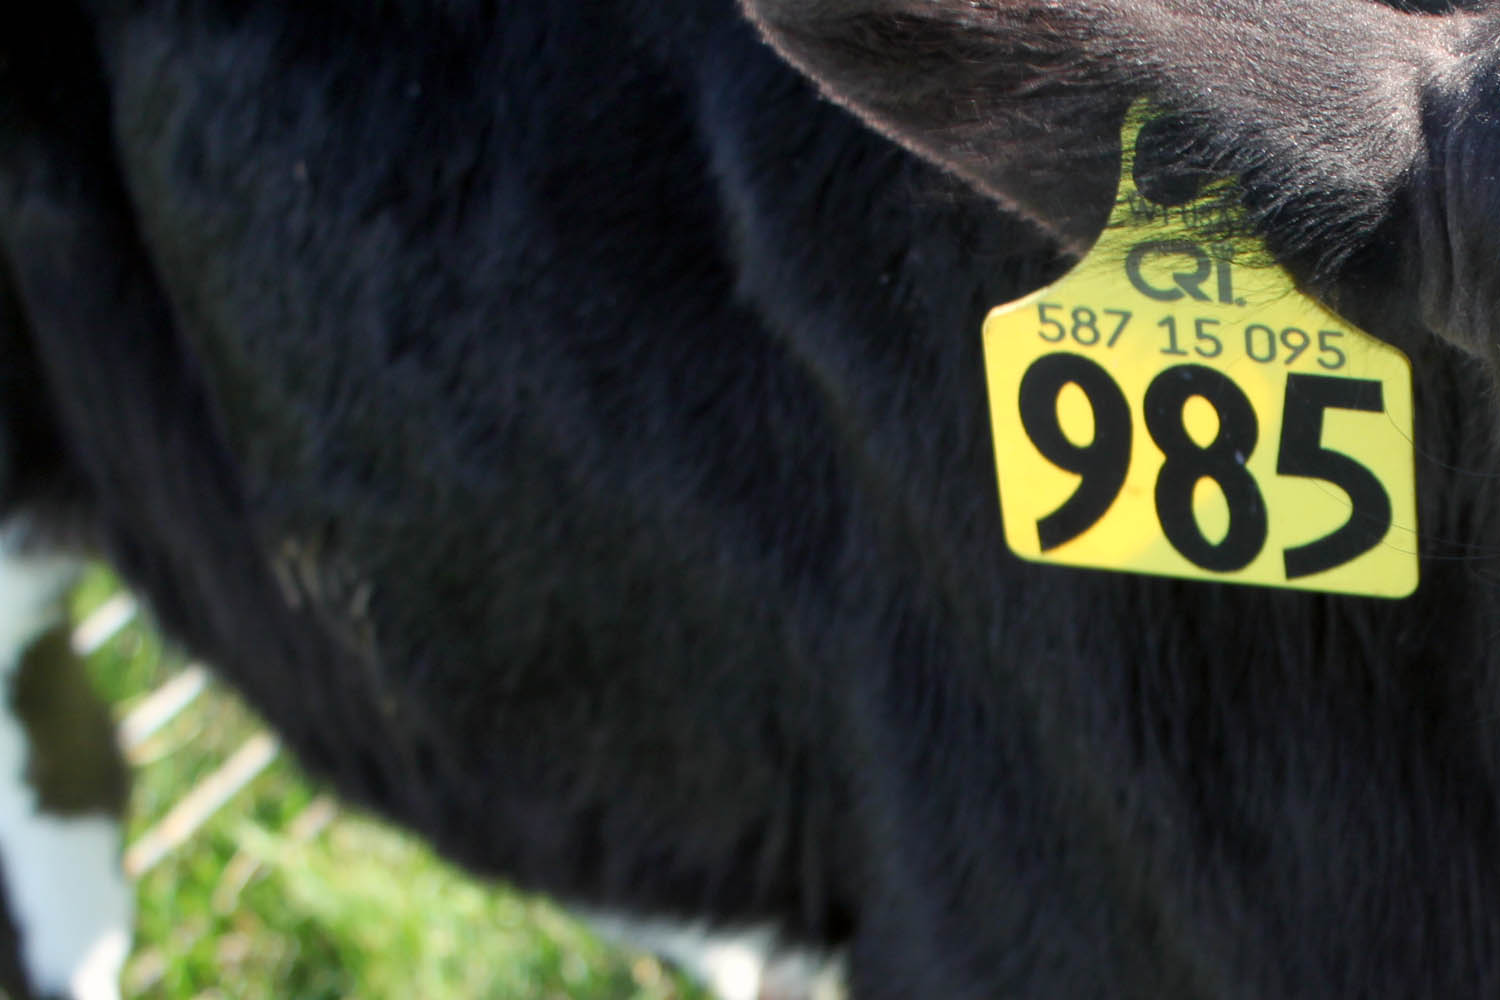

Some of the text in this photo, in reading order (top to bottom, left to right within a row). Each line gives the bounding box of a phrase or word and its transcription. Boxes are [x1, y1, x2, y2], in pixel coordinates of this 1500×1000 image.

[1037, 302, 1347, 370] 587 15 095
[1018, 351, 1393, 581] 985
